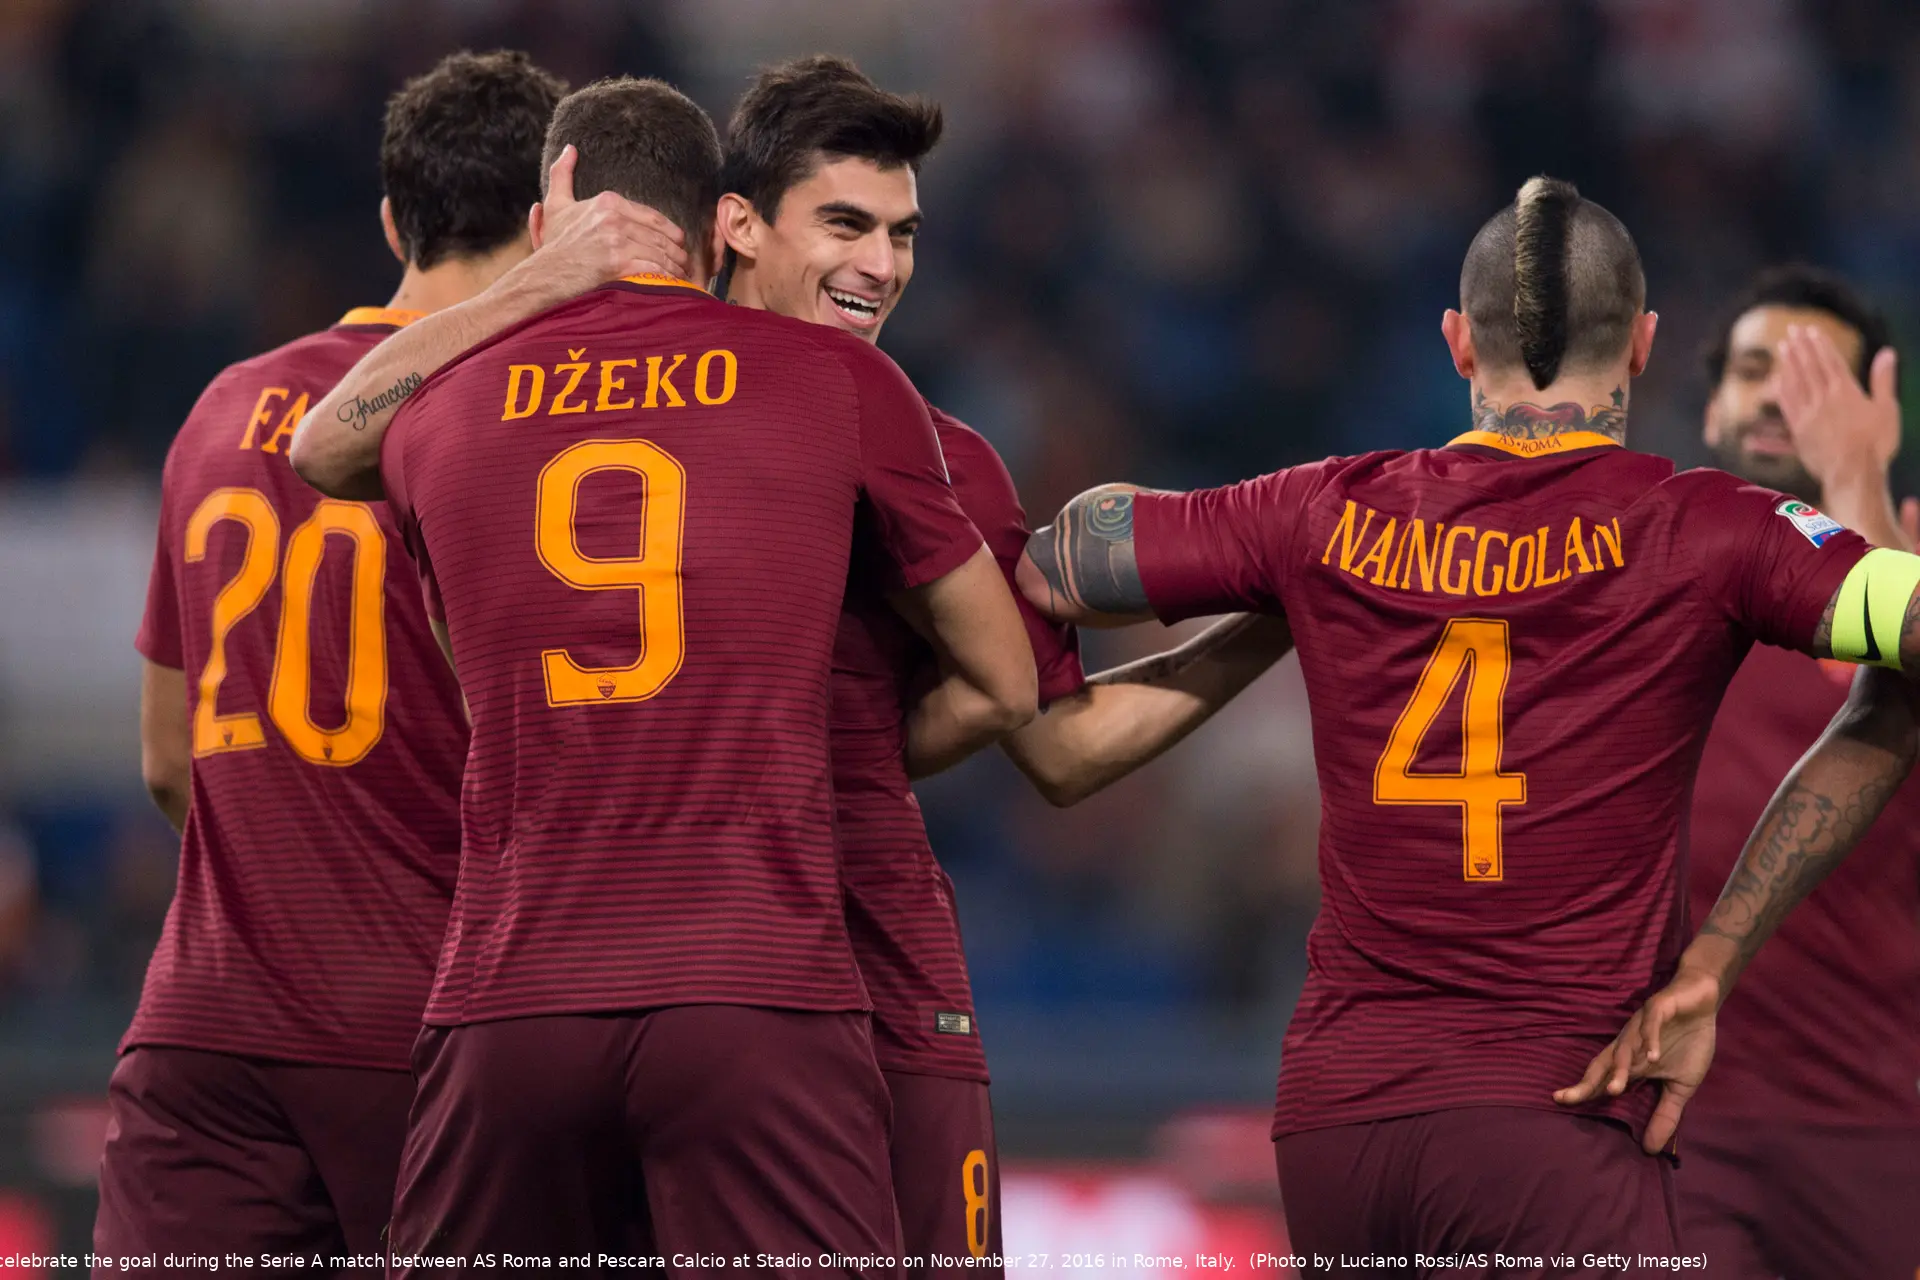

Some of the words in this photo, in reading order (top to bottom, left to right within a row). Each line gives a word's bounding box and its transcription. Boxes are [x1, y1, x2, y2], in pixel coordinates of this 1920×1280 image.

[337, 371, 423, 431] Francesco
[501, 347, 738, 421] DŽEKO
[535, 438, 687, 708] 9
[1322, 499, 1625, 598] NAINGGOLAN
[184, 486, 389, 768] 20
[1373, 616, 1527, 881] 4
[962, 1149, 989, 1261] 8
